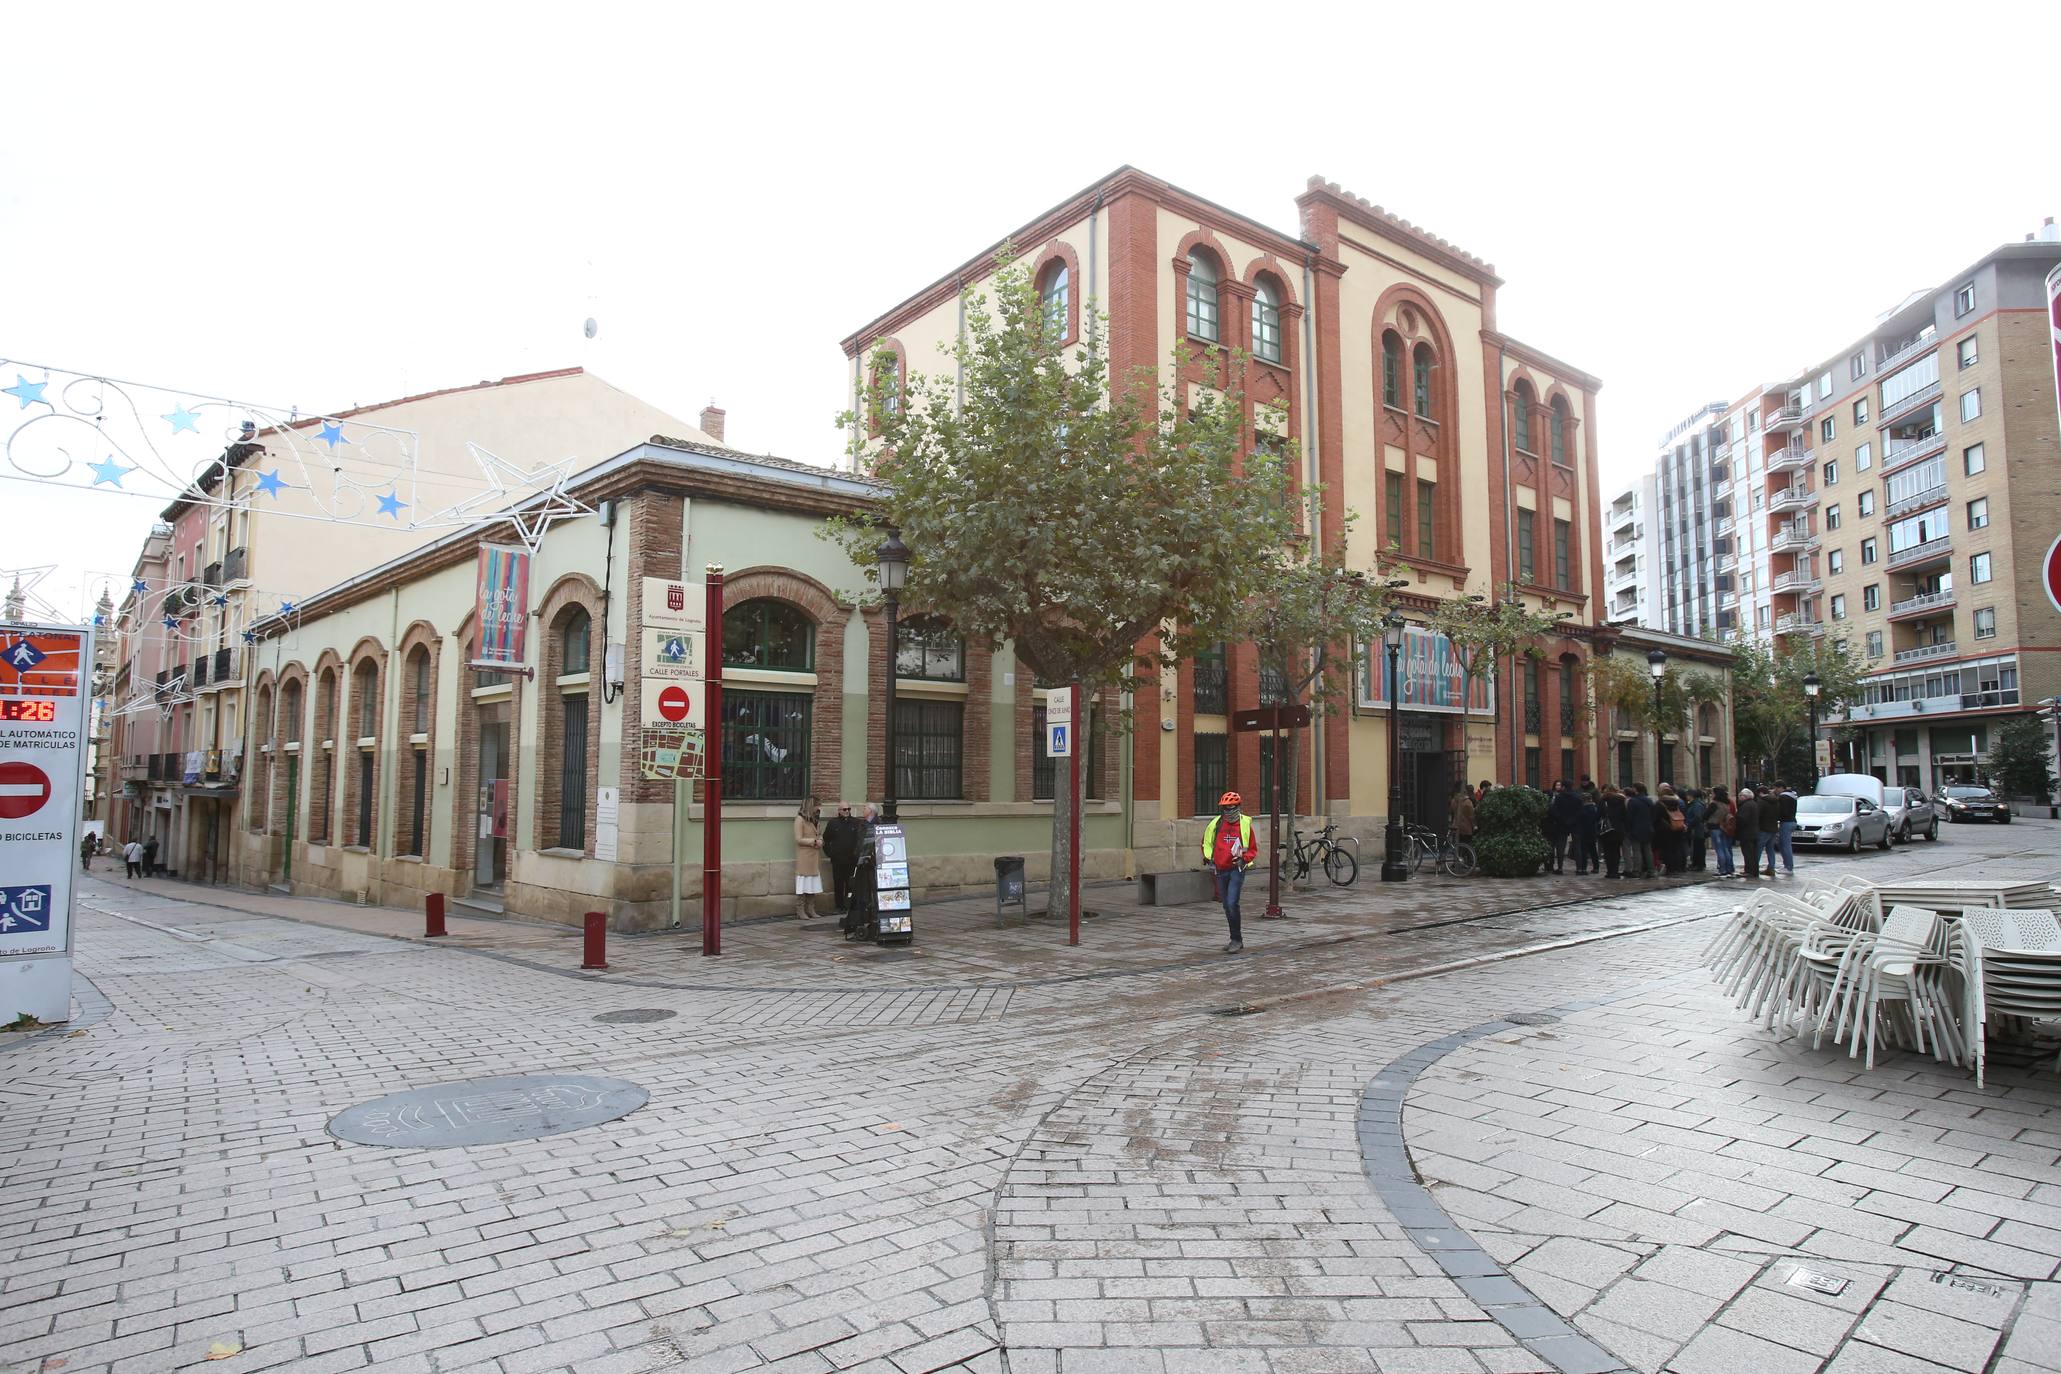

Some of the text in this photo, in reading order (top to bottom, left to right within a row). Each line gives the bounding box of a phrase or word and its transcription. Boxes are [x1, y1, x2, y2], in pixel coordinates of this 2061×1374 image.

[670, 669, 699, 677] PORTALES
[9, 729, 76, 739] AUTOMÁTICO
[5, 832, 63, 841] BICICLETAS
[23, 945, 56, 953] Logroño
